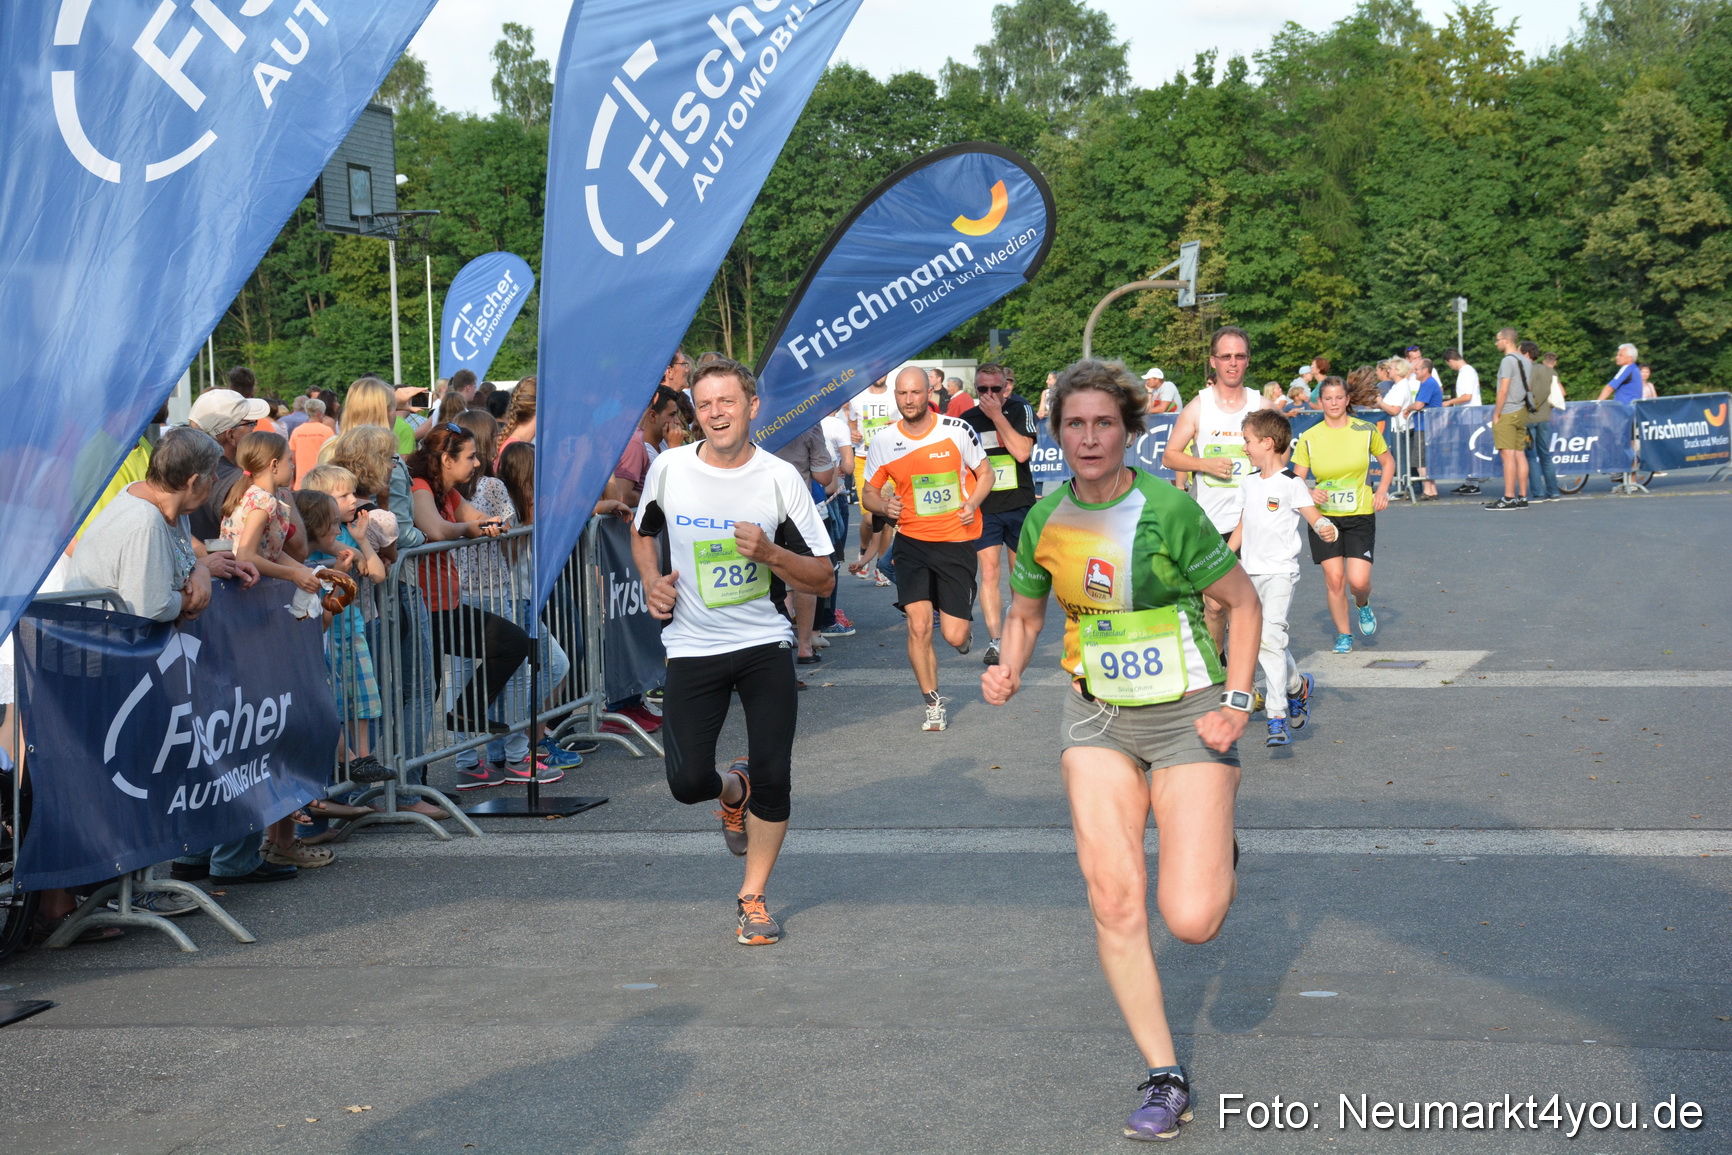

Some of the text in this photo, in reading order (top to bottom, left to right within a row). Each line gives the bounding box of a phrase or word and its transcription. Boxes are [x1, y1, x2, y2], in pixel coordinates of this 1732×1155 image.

[628, 0, 782, 208] Fisch
[692, 0, 818, 203] AUTOMOBIL
[910, 227, 1037, 314] Druck und Medien
[463, 269, 514, 348] Fischer
[482, 283, 520, 346] AUTOMOBILE
[787, 241, 974, 370] Frischmann
[751, 368, 856, 444] .frischmann-net.de
[1640, 418, 1710, 441] Frischmann
[1683, 439, 1700, 449] Druck
[1700, 436, 1712, 448] und
[922, 488, 952, 505] 493
[1329, 491, 1354, 504] 175
[712, 562, 758, 589] 282
[1090, 591, 1108, 600] 1628
[1100, 646, 1164, 680] 988
[152, 685, 292, 774] Fischer
[167, 753, 271, 815] AUTOMOBILE
